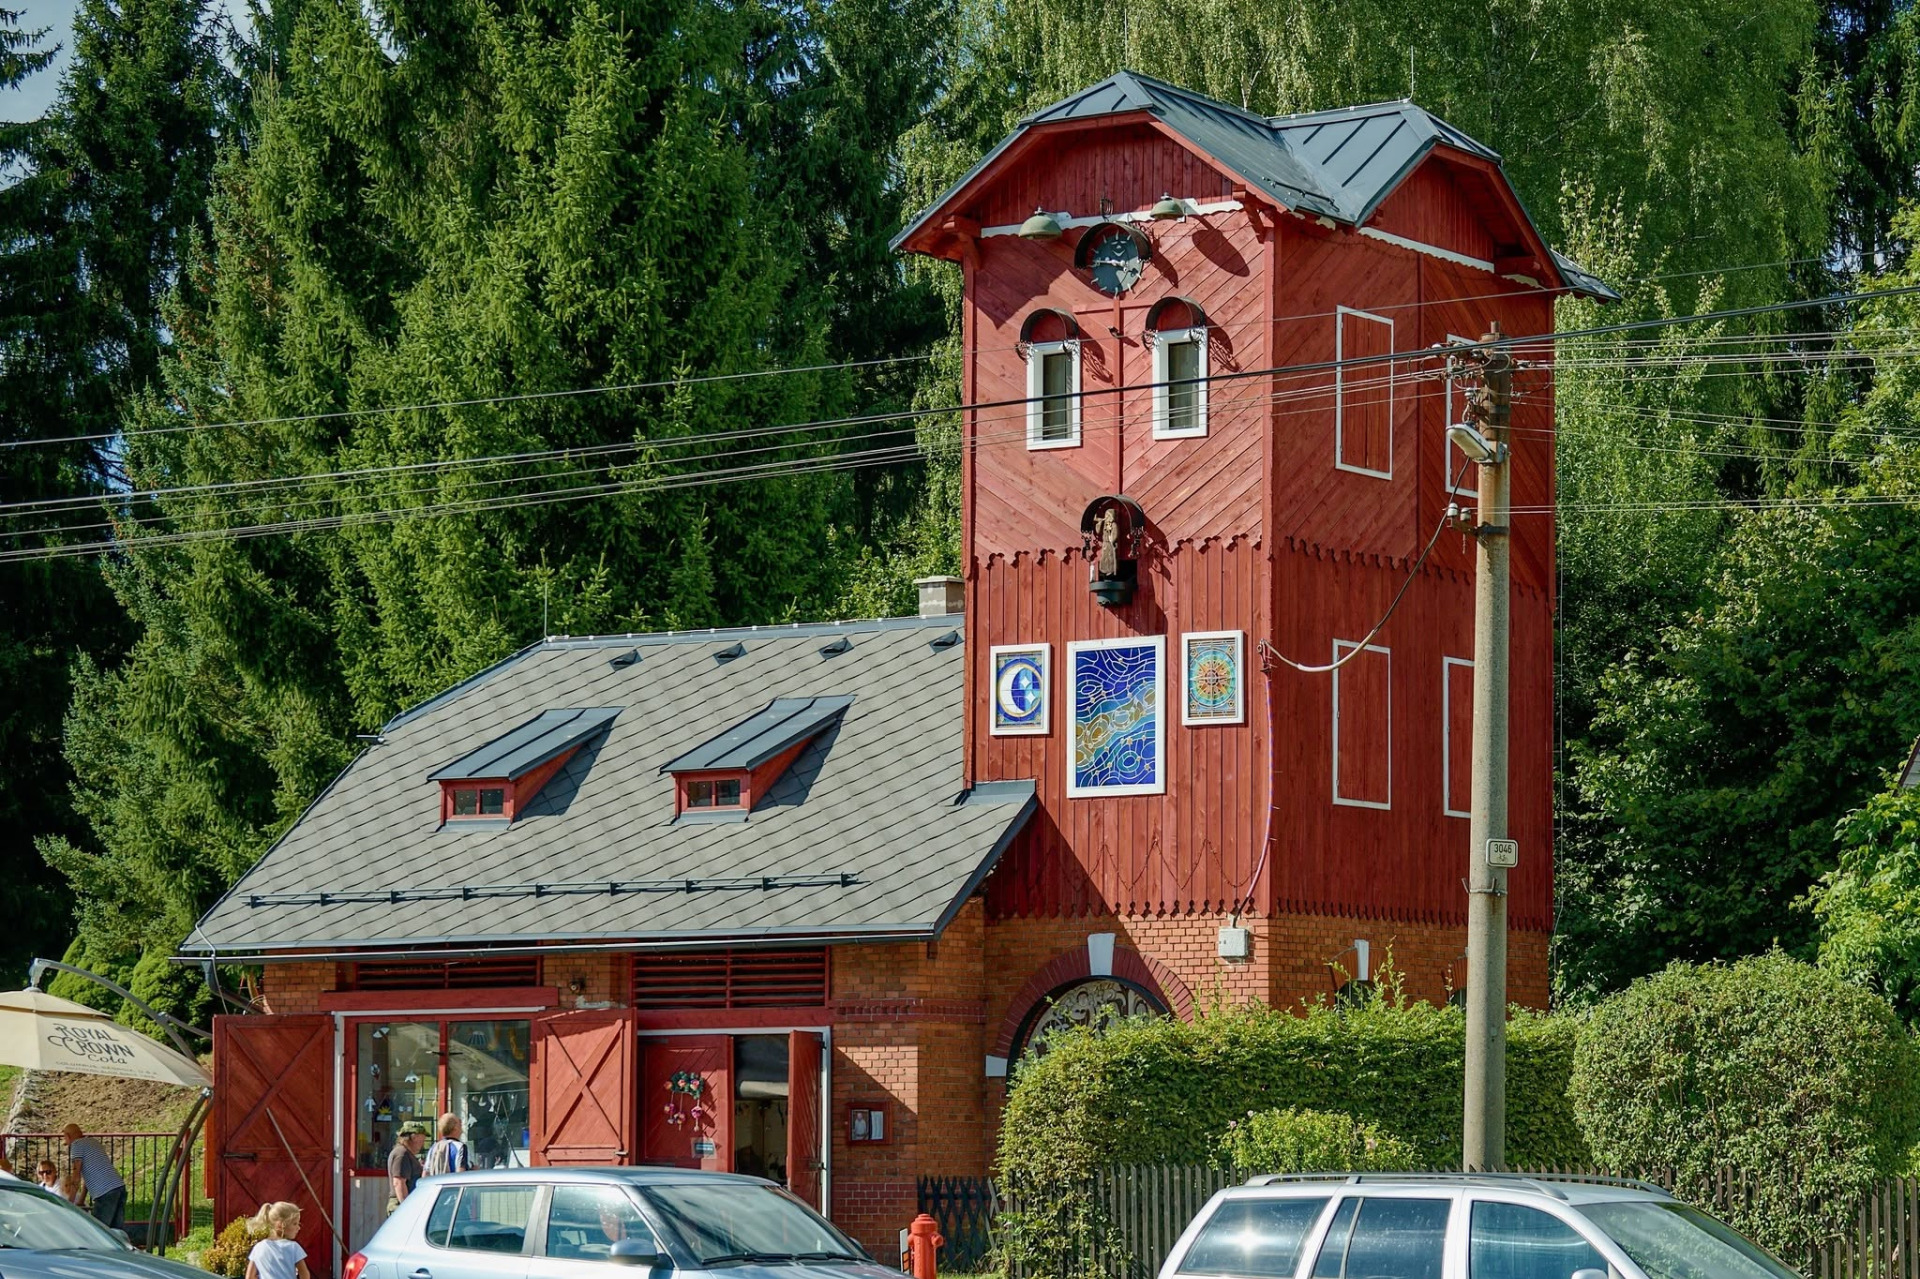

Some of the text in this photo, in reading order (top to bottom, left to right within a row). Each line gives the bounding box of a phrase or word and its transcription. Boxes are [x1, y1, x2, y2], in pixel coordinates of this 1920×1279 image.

[1494, 843, 1512, 854] 3046
[53, 1023, 120, 1042] ROYAL
[47, 1035, 135, 1058] CROWN
[87, 1054, 128, 1065] Cola
